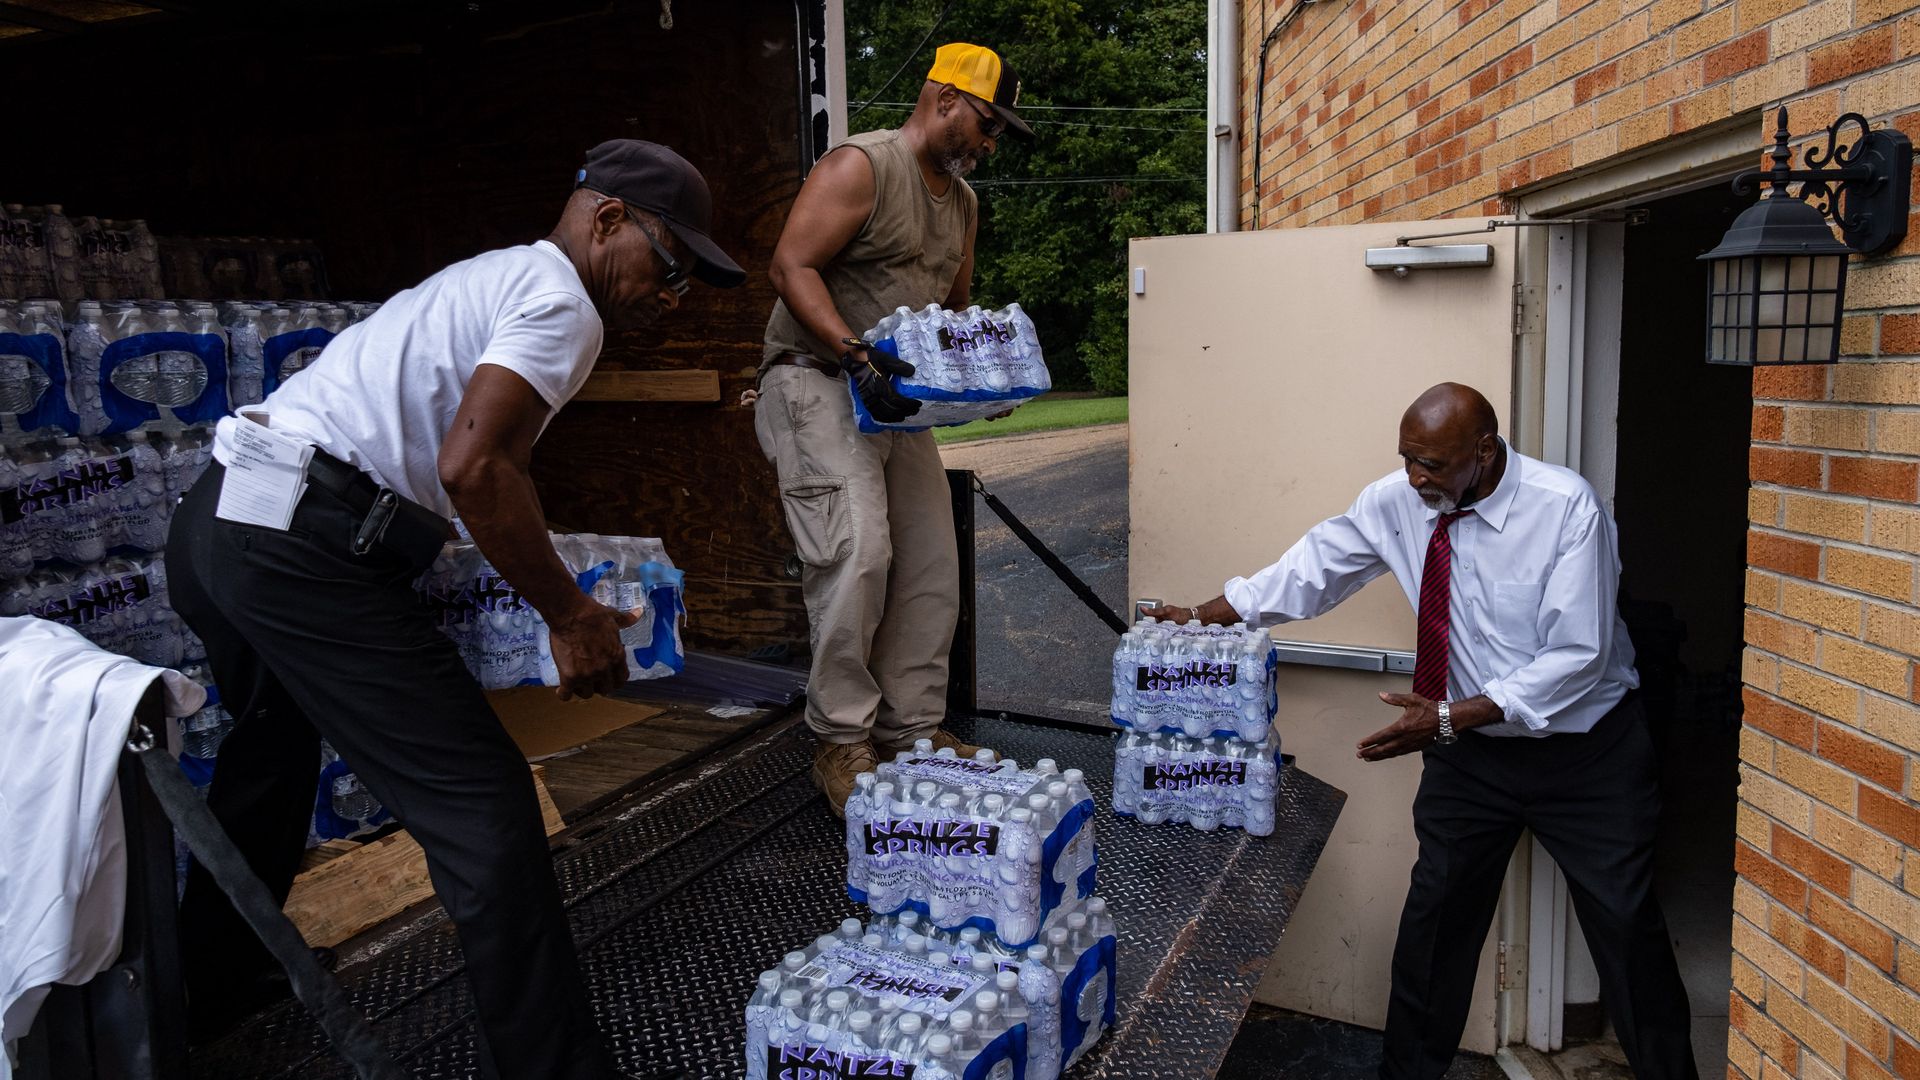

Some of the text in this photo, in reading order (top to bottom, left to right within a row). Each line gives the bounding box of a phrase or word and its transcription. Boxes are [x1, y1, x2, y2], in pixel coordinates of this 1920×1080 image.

[1147, 656, 1231, 678] NANTZE
[1146, 674, 1229, 693] SPRINGS
[1156, 756, 1241, 777] NANTZE
[1155, 774, 1239, 793] SPRINGS
[870, 817, 992, 838] NANTZE
[872, 837, 989, 861] SPRINGS
[780, 1041, 907, 1077] NANTZE
